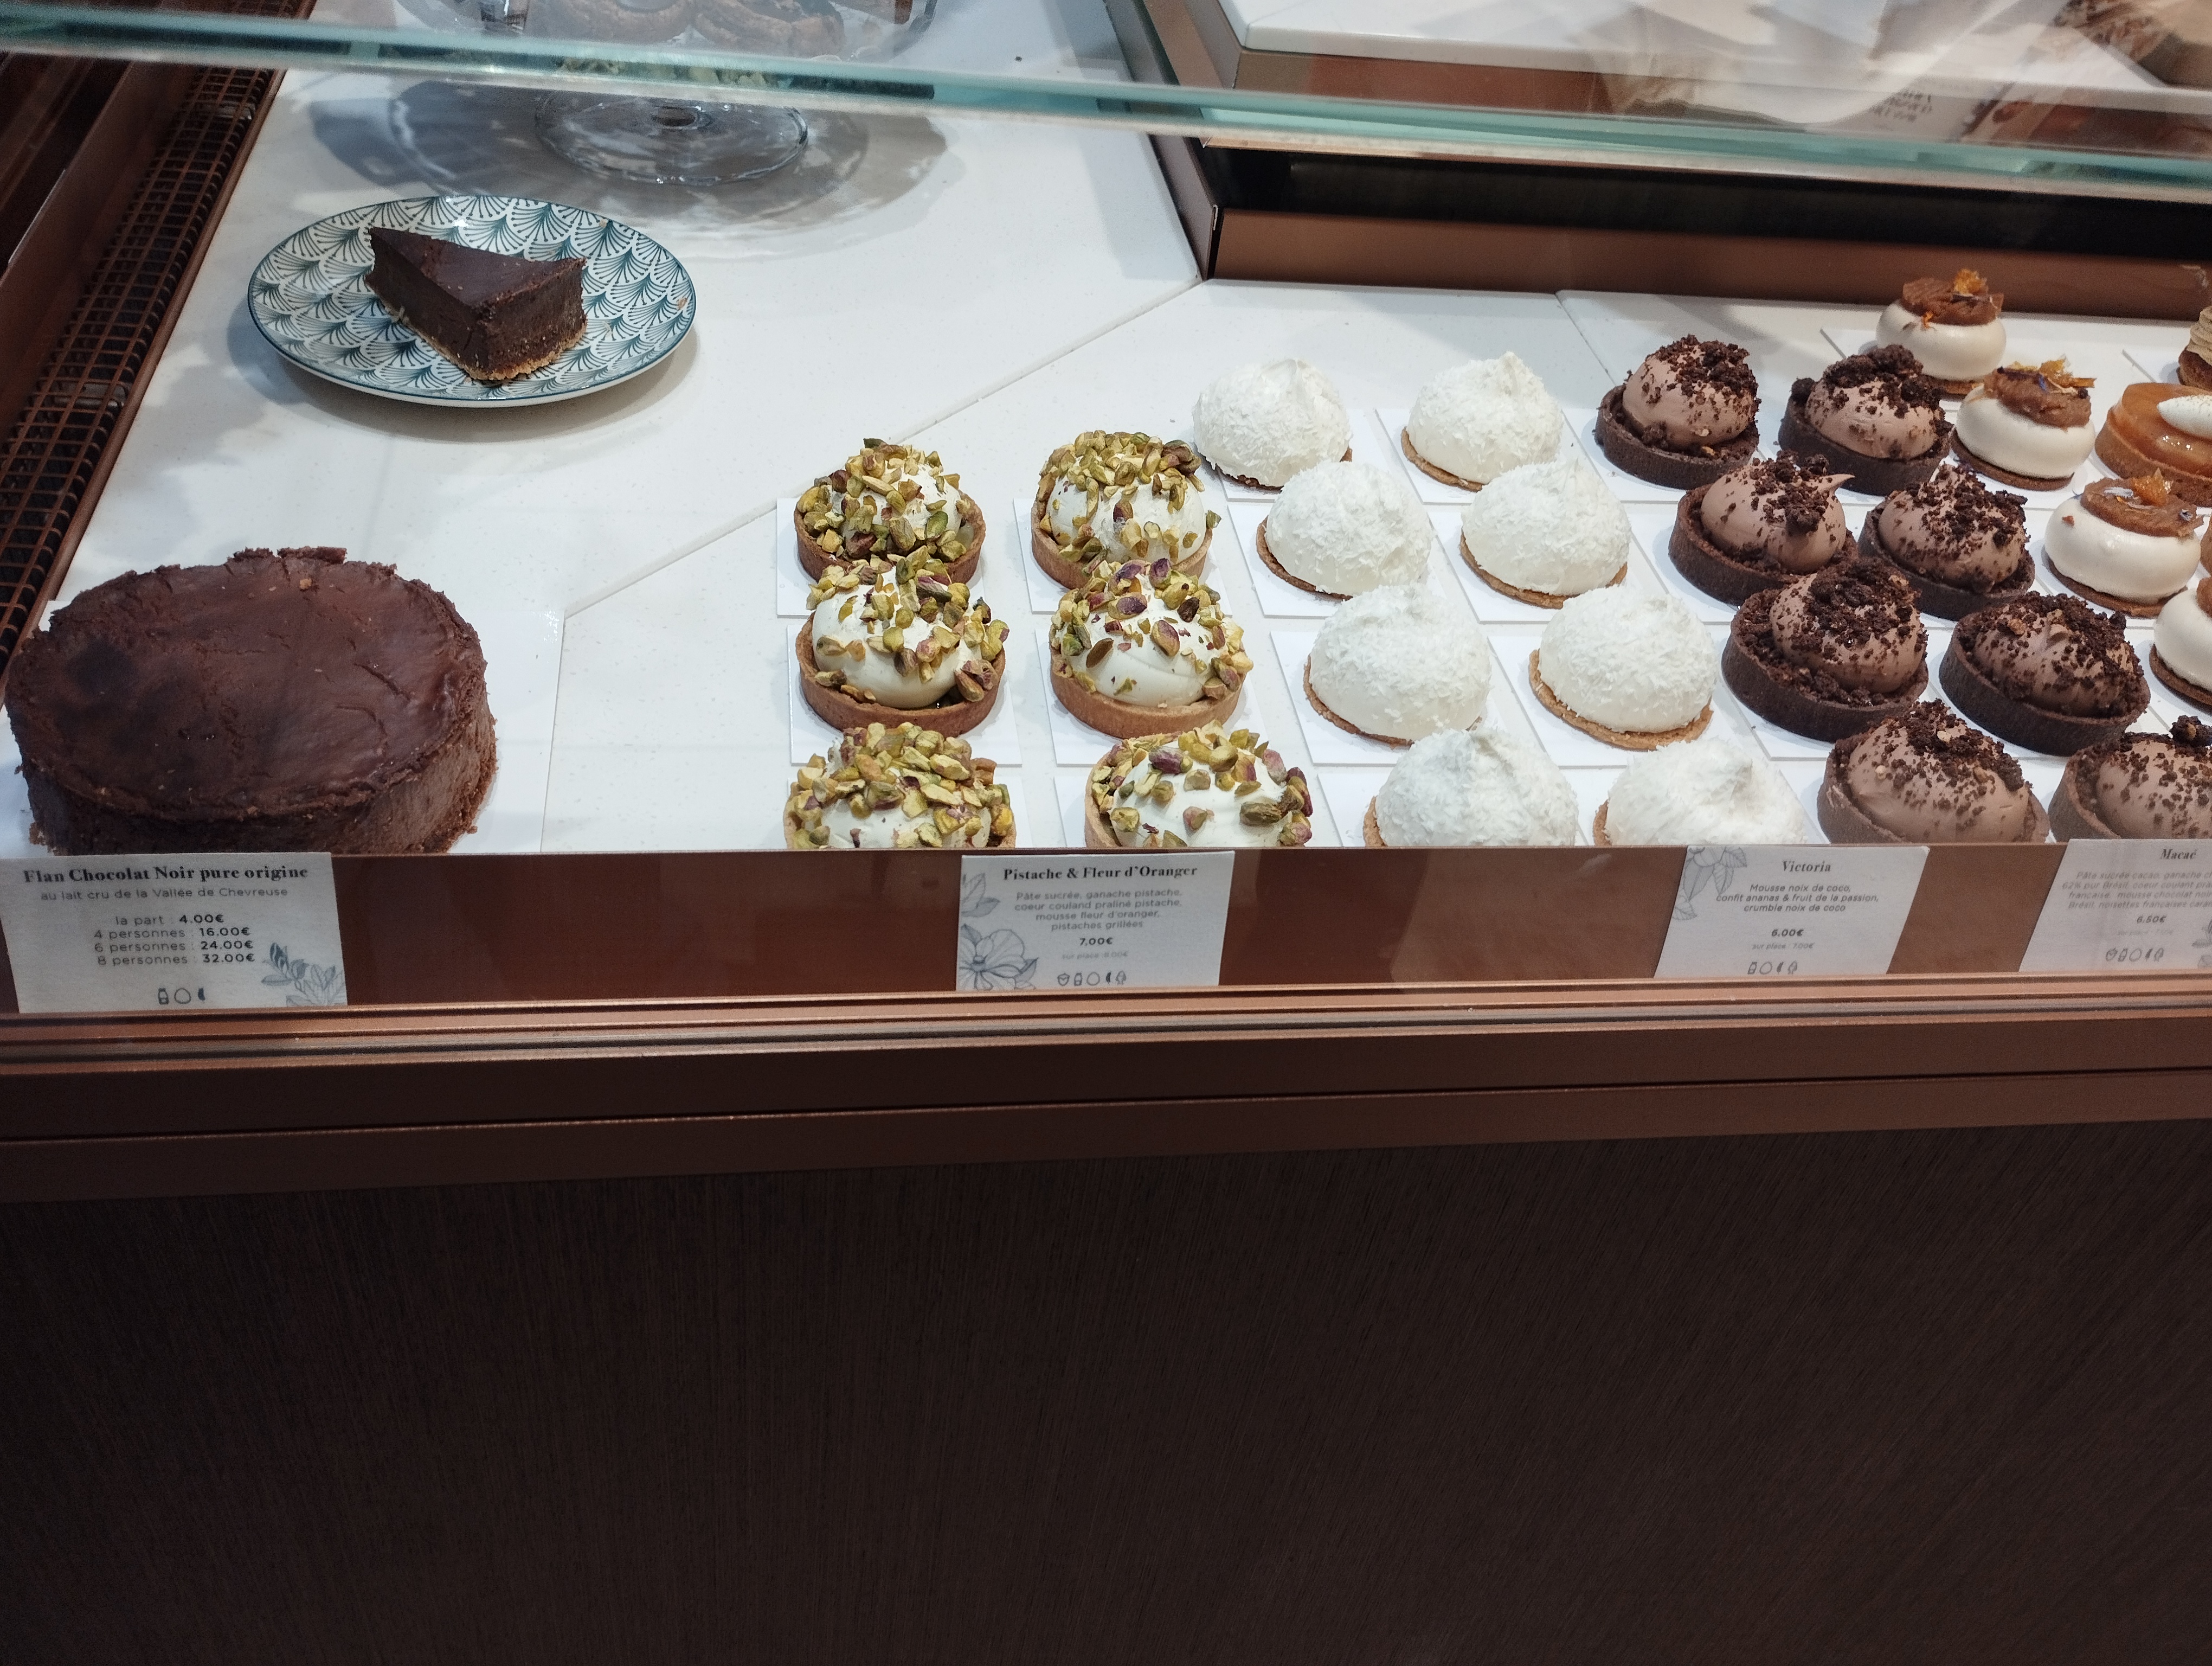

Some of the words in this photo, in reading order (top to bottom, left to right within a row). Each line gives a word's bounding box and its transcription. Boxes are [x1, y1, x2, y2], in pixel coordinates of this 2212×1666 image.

[2159, 848, 2198, 860] Macaé
[1782, 860, 1831, 872] Victoria
[23, 870, 65, 883] Flan
[69, 868, 151, 882] Chocolat
[155, 866, 195, 879] Noir
[200, 869, 240, 882] pure
[245, 866, 308, 882] origine
[1003, 868, 1063, 880] Pistache
[1066, 868, 1078, 879] &
[1083, 867, 1121, 879] Fleur
[2163, 872, 2201, 881] ganache
[62, 891, 82, 900] lait
[87, 891, 109, 899] cru
[114, 889, 131, 899] de
[136, 889, 147, 898] la
[152, 887, 192, 898] Vallée
[198, 888, 214, 897] de
[219, 888, 288, 897] Chevreuse
[1750, 883, 1785, 892] Mousse
[1789, 883, 1808, 892] noix
[1812, 883, 1824, 892] de
[1827, 884, 1851, 893] coco,
[1016, 891, 1041, 901] Pâte
[1086, 889, 1131, 900] ganache
[1716, 893, 1744, 902] confit
[1782, 894, 1790, 902] &
[1792, 893, 1812, 902] fruit
[1816, 893, 1827, 902] de
[1830, 894, 1838, 902] la
[1840, 894, 1879, 903] passion,
[2153, 890, 2193, 899] chocolat
[1014, 903, 1045, 911] coeur
[1095, 900, 1131, 910] praliné
[1744, 904, 1783, 912] crumble
[1785, 904, 1805, 912] noix
[1809, 904, 1820, 912] de
[115, 917, 128, 925] la
[134, 915, 164, 926] part
[179, 914, 224, 924] 4.00€
[1036, 912, 1077, 921] mousse
[1081, 911, 1104, 919] fleur
[1051, 921, 1102, 932] pistaches
[1105, 919, 1143, 930] grillées
[94, 930, 103, 939] 4
[109, 930, 186, 940] personnes
[199, 927, 250, 937] 16.00€
[1771, 928, 1804, 937] 6.00€
[94, 943, 104, 952] 6
[110, 943, 187, 953] personnes
[201, 940, 253, 950] 24.00€
[1079, 937, 1113, 946] 7.00€
[98, 956, 106, 965] 8
[112, 956, 188, 966] personnes
[202, 953, 255, 963] 32.00€
